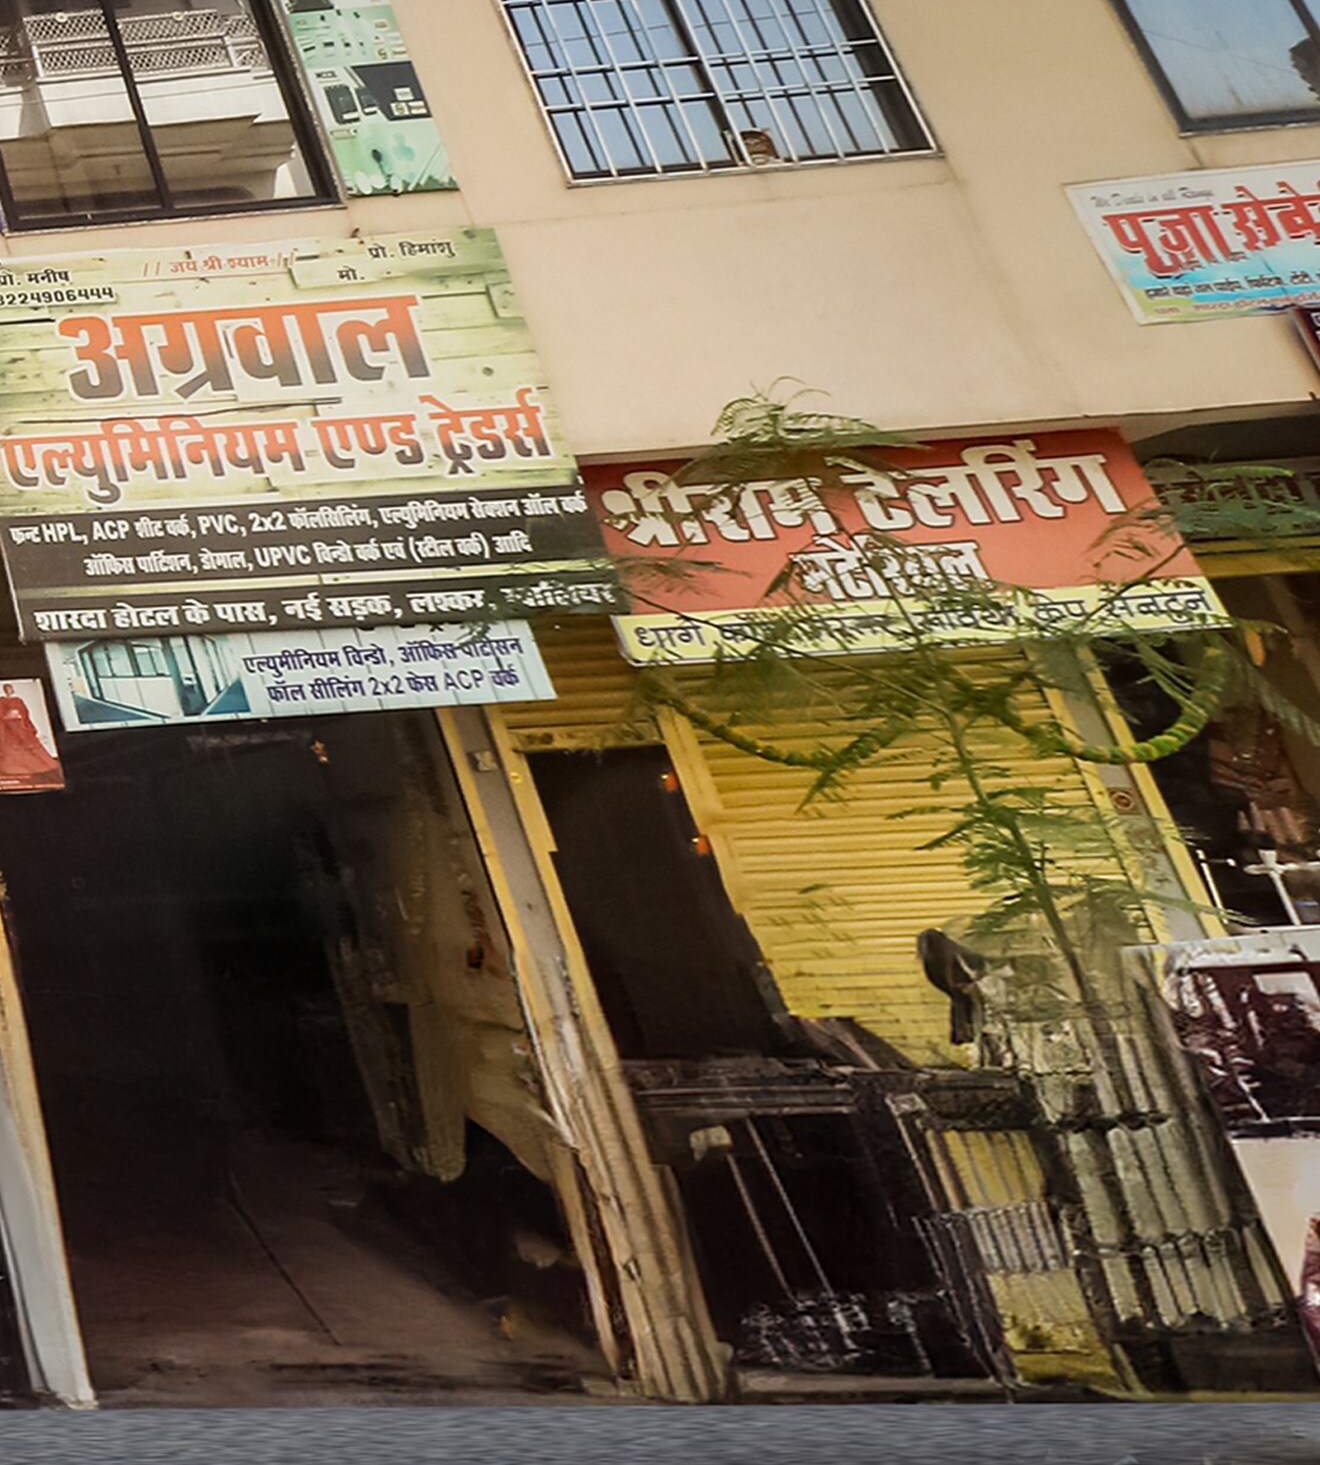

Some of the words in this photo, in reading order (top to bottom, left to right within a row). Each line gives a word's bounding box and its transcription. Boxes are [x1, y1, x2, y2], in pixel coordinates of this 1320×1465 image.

[368, 243, 394, 258] प्रो.
[399, 239, 455, 258] हिमांशु
[1102, 204, 1233, 278] पूजा
[170, 260, 197, 274] जय
[203, 256, 222, 271] श्री
[226, 254, 268, 269] श्याम
[337, 265, 365, 281] मो.
[58, 295, 431, 401] अग्रवाल
[0, 408, 303, 502] एल्युमिनियम
[313, 411, 422, 471] एण्ड
[420, 387, 552, 477] ट्रेडर्स
[602, 471, 838, 548] श्रीराम
[826, 440, 1128, 533] टेलरिंग
[41, 523, 89, 546] HPL,
[92, 520, 130, 541] ACP
[134, 516, 164, 538] शीट
[166, 514, 197, 538] वर्क,
[197, 513, 247, 537] PVC,
[248, 511, 287, 532] 2x2
[522, 493, 558, 516] ऑल
[559, 489, 588, 515] वर्क
[84, 552, 136, 576] ऑफिस
[200, 548, 253, 572] डोमाल,
[254, 542, 312, 567] UPVC
[313, 539, 354, 564] विन्डो
[356, 537, 381, 562] वर्क
[382, 537, 407, 560] एवं
[409, 535, 456, 563] (स्टील
[456, 531, 490, 559] वर्क)
[491, 530, 533, 554] आदि
[34, 607, 107, 632] शारदा
[111, 602, 179, 628] होटल
[182, 599, 210, 625] के
[214, 601, 277, 626] पास,
[282, 592, 323, 621] नई
[326, 594, 403, 622] सड़क,
[243, 649, 341, 678] एल्युमीनियम
[345, 644, 394, 667] विन्डो,
[398, 639, 458, 665] ऑफिस
[266, 679, 304, 702] फॉल
[311, 675, 364, 699] सीलिंग
[370, 676, 405, 697] 2x2
[444, 669, 484, 690] ACP
[490, 664, 521, 687] वर्क
